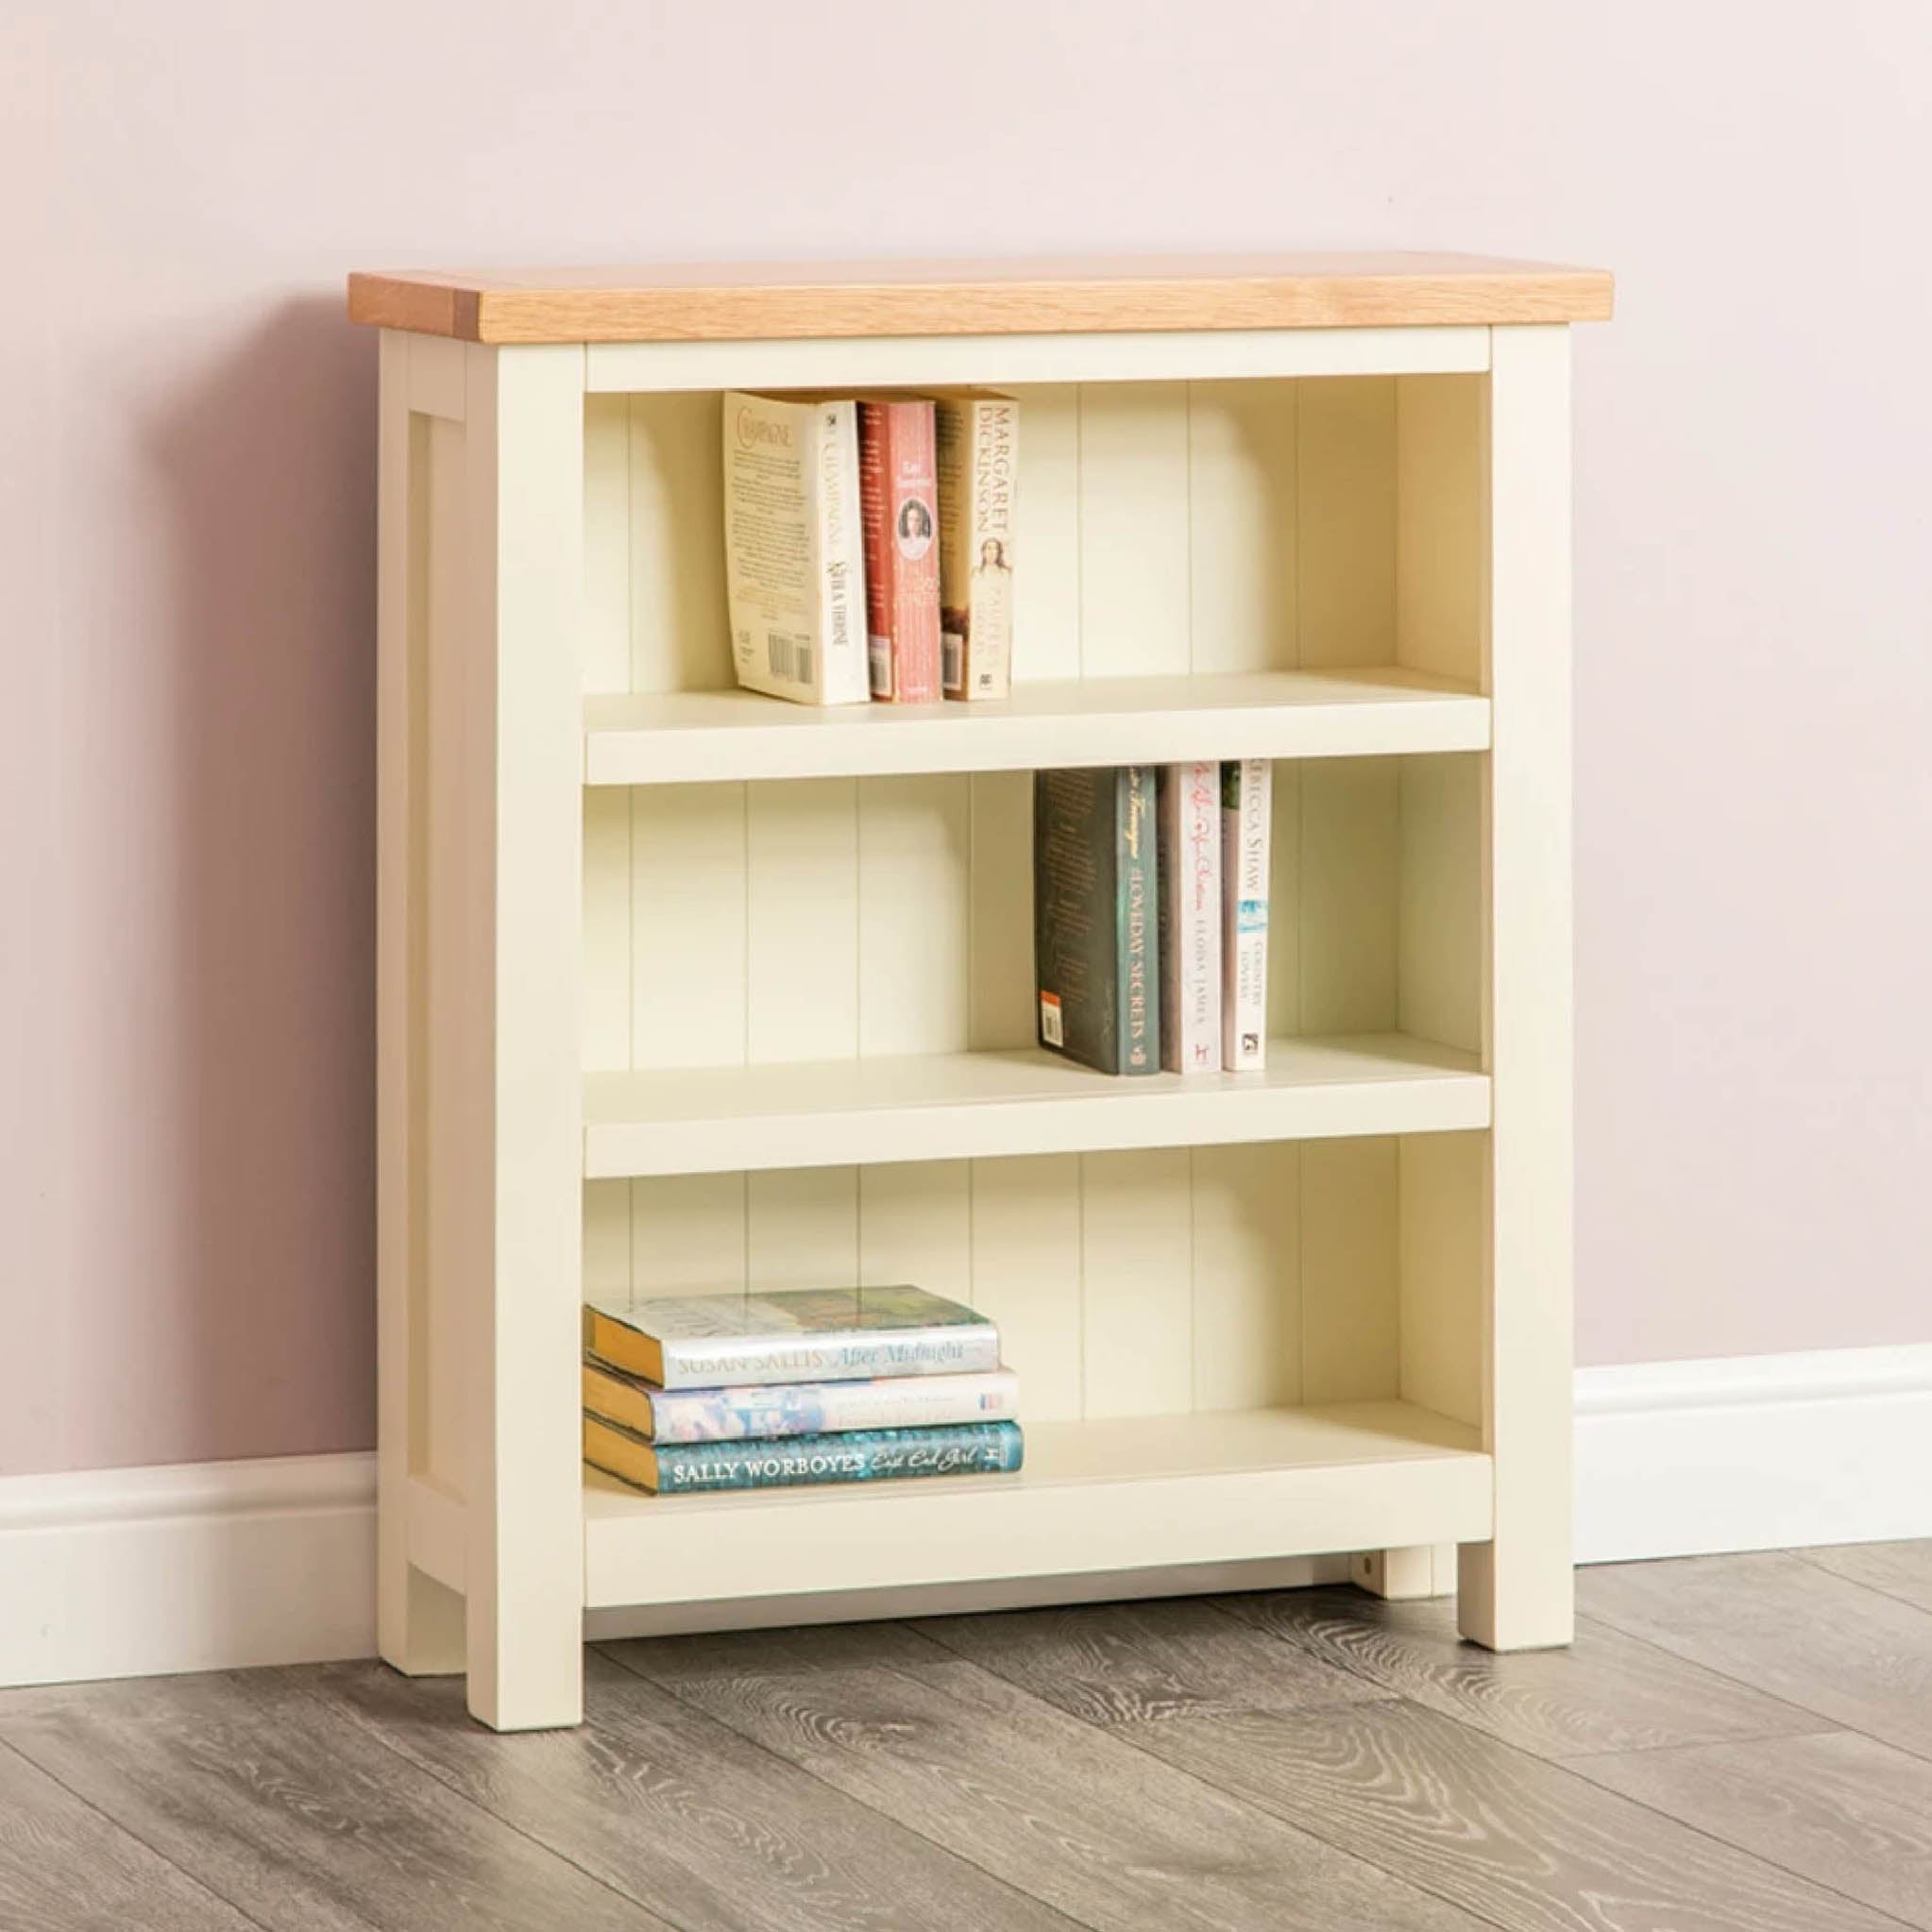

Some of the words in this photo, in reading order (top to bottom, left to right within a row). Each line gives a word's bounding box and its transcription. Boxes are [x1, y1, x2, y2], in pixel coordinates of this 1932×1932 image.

[978, 407, 992, 533] DICKINSON
[993, 407, 1010, 533] MARGARET
[1246, 838, 1263, 892] SHAW
[1129, 959, 1145, 1039] SECRETS
[677, 1356, 748, 1376] SUSAN
[754, 1348, 824, 1369] SALLIS
[883, 1341, 965, 1364] Midnight
[672, 1461, 739, 1483] SALLY
[744, 1453, 866, 1478] WORBOYES
